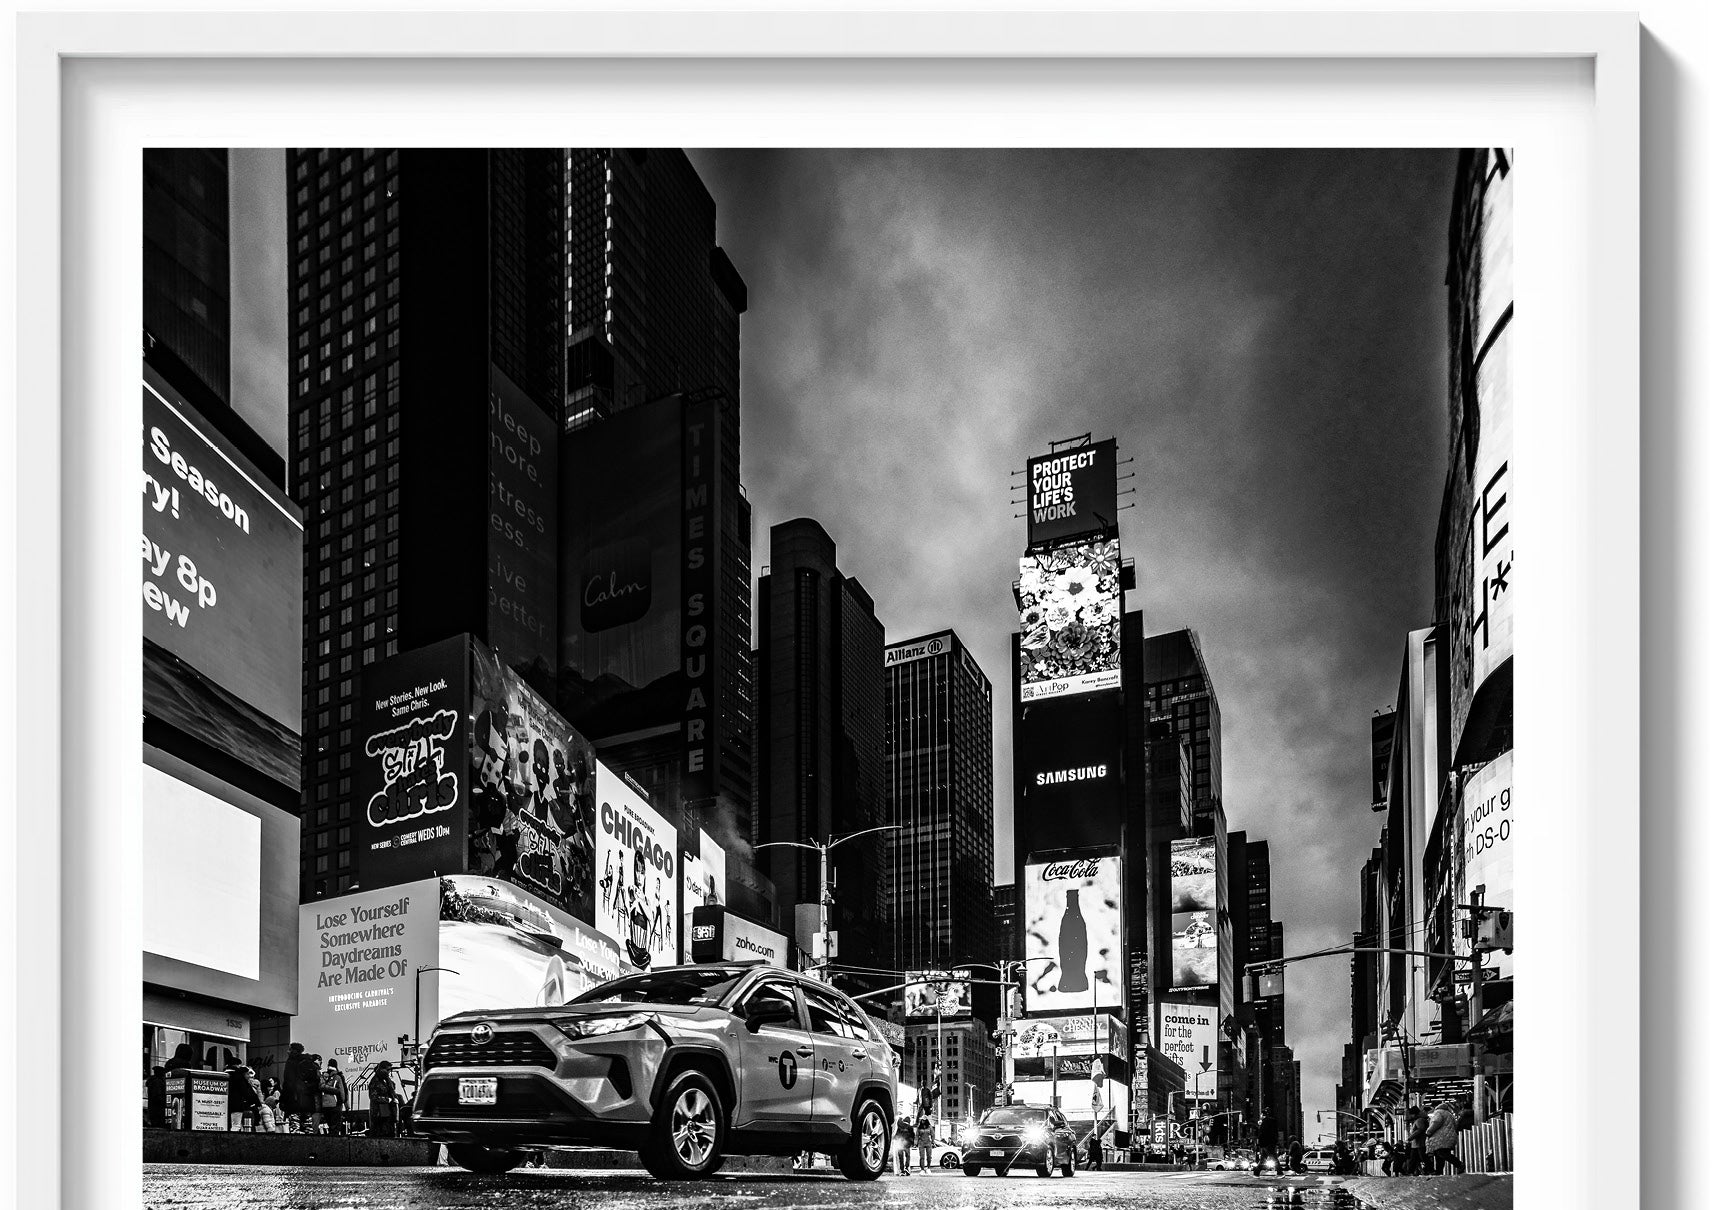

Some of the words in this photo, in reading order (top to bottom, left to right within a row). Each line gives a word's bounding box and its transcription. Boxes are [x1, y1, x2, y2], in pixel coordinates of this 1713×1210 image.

[1032, 450, 1096, 479] PROTECT
[150, 426, 250, 535] Season
[1032, 471, 1072, 495] YOUR
[686, 423, 708, 571] TIMES
[1033, 486, 1074, 510] LIFE'S
[1033, 502, 1076, 524] WORK
[176, 554, 217, 609] 8p
[583, 572, 648, 609] Calm
[886, 646, 926, 664] Allianz
[375, 699, 389, 711] New
[389, 690, 414, 708] Stories.
[414, 683, 429, 698] New
[429, 678, 448, 694] Look.
[685, 593, 708, 773] SQUARE
[391, 702, 410, 718] Same
[410, 697, 430, 714] Chris.
[1036, 764, 1107, 786] SAMSUNG
[417, 826, 435, 842] WEDS
[601, 802, 674, 879] CHICAGO
[1042, 857, 1099, 882] Coca-Cola
[316, 911, 347, 931] Lose
[350, 897, 410, 925] Yourself
[320, 922, 405, 949] Somewhere
[736, 936, 775, 959] zoho.com
[322, 944, 403, 971] Daydreams
[317, 970, 343, 989] Are
[345, 962, 385, 985] Made
[388, 958, 408, 979] Of
[1164, 1024, 1177, 1038] for
[1178, 1025, 1192, 1039] the
[1165, 1015, 1196, 1025] come
[1197, 1015, 1210, 1026] in
[335, 1040, 388, 1056] CELEBRATION
[353, 1052, 371, 1065] KEY
[1164, 1040, 1194, 1055] perfect
[1155, 1121, 1166, 1143] tkts
